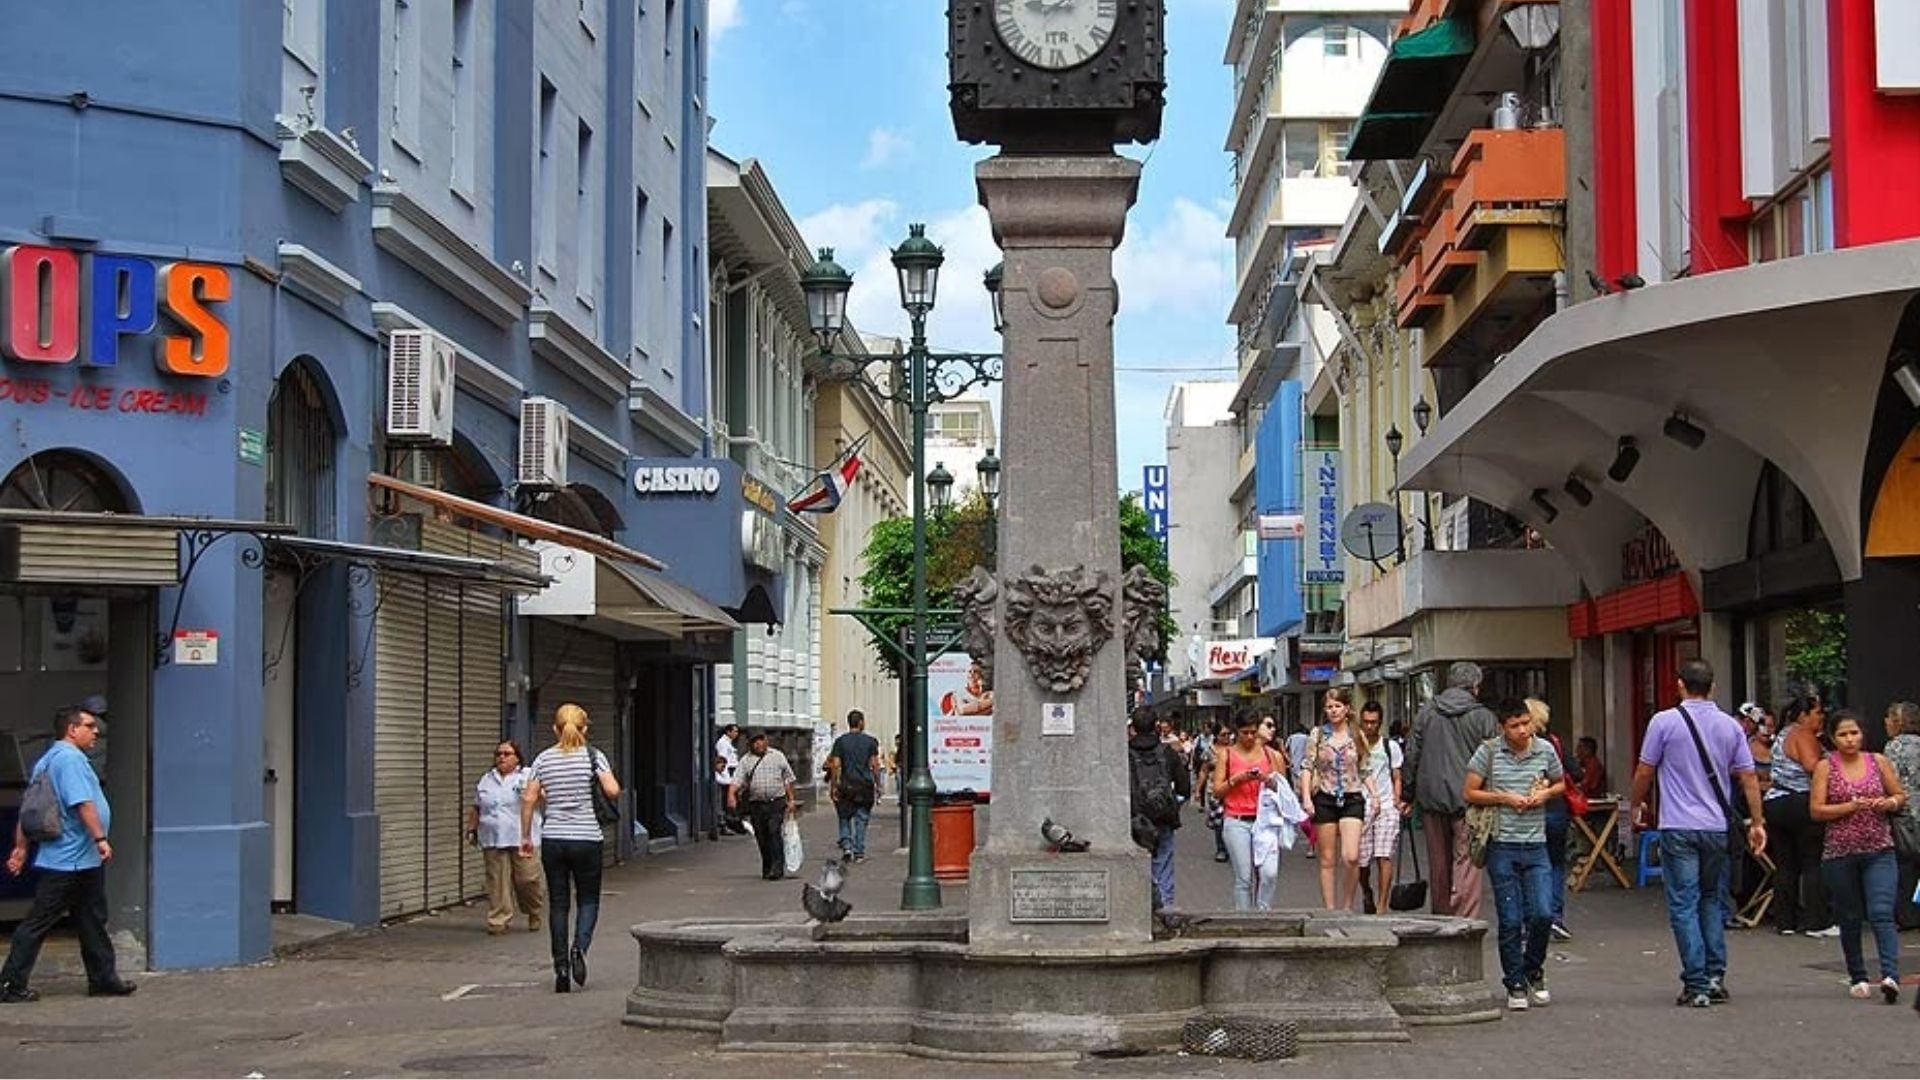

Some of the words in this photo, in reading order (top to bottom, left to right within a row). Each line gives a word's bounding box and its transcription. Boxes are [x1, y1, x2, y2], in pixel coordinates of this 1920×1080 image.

[1045, 31, 1069, 44] ITR
[6, 244, 231, 377] OPS
[68, 383, 114, 412] ICE
[117, 388, 209, 416] CREAM
[634, 467, 719, 492] CASINO
[1318, 452, 1337, 570] INTERNET
[1209, 645, 1248, 665] flexi
